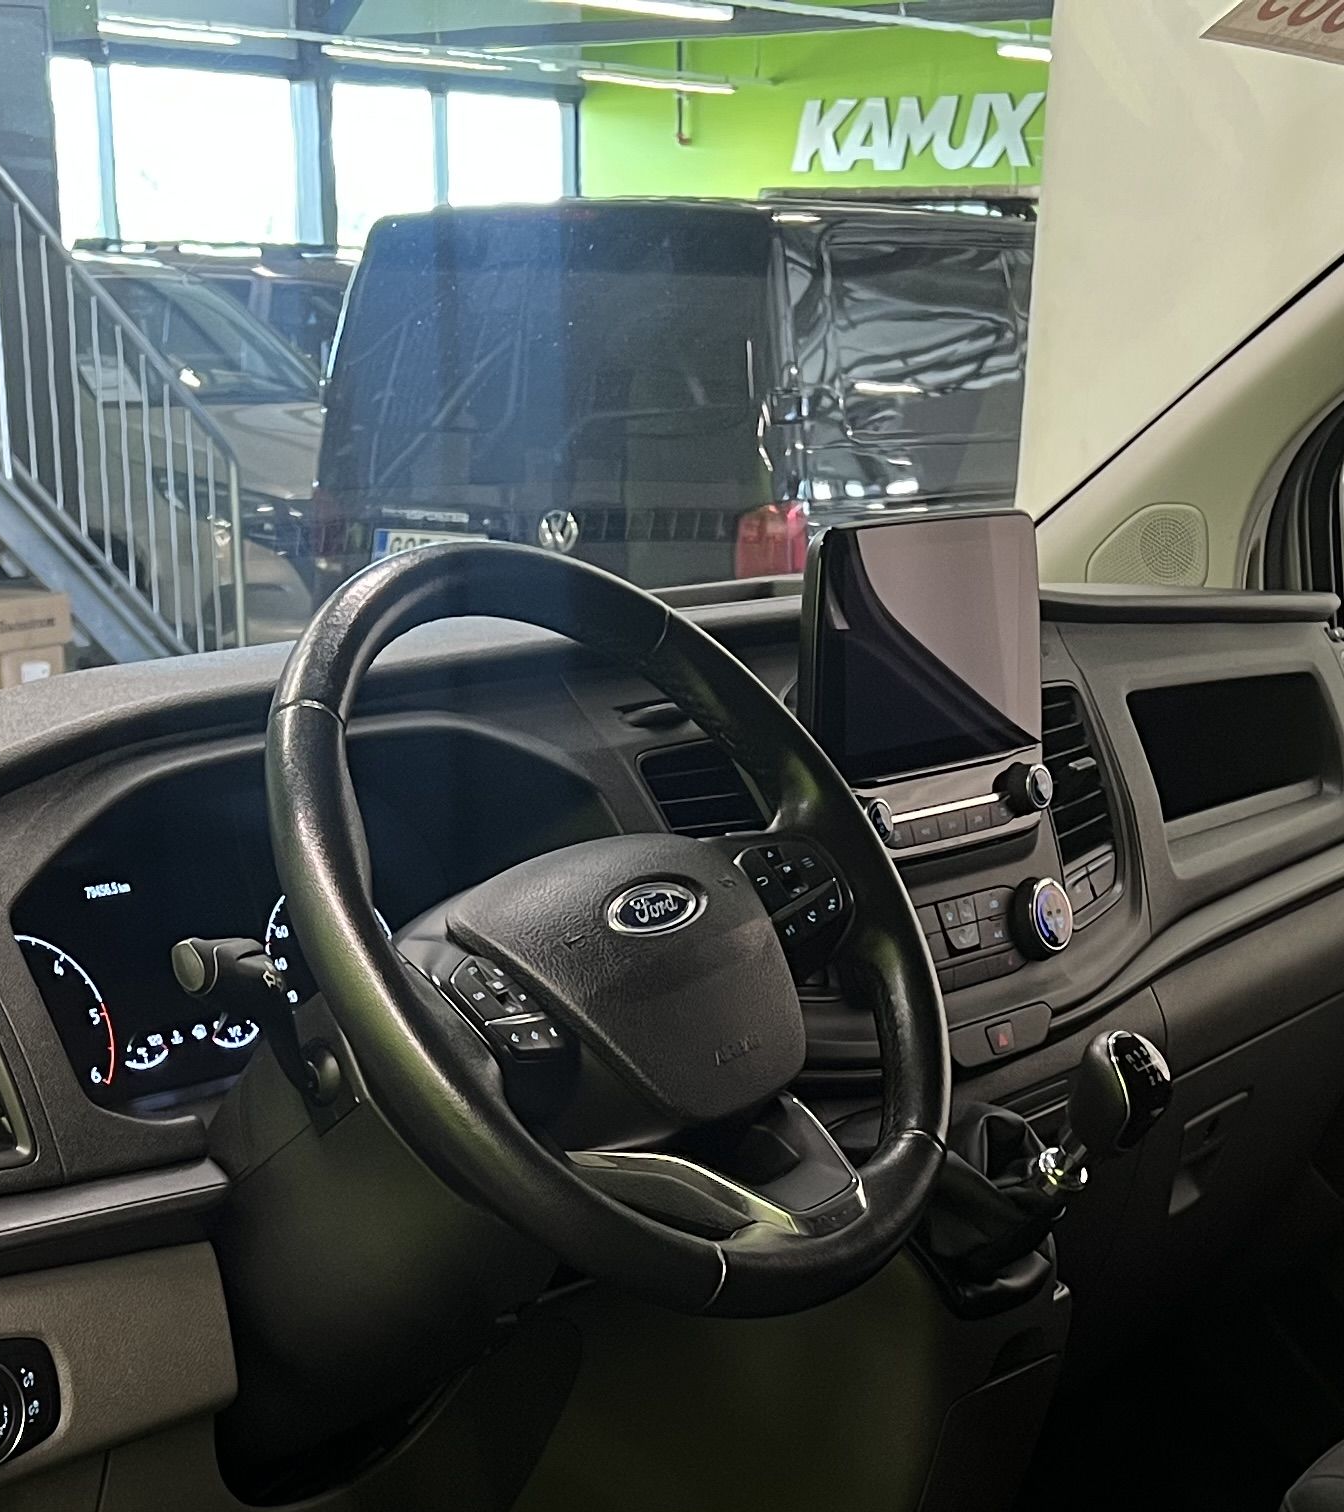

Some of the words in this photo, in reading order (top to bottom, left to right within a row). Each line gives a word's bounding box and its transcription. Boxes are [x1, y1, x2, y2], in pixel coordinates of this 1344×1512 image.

[791, 92, 1046, 173] KAMUX
[629, 892, 679, 923] Ford
[275, 924, 289, 939] 60
[89, 1008, 101, 1026] 5
[90, 1066, 102, 1084] 6
